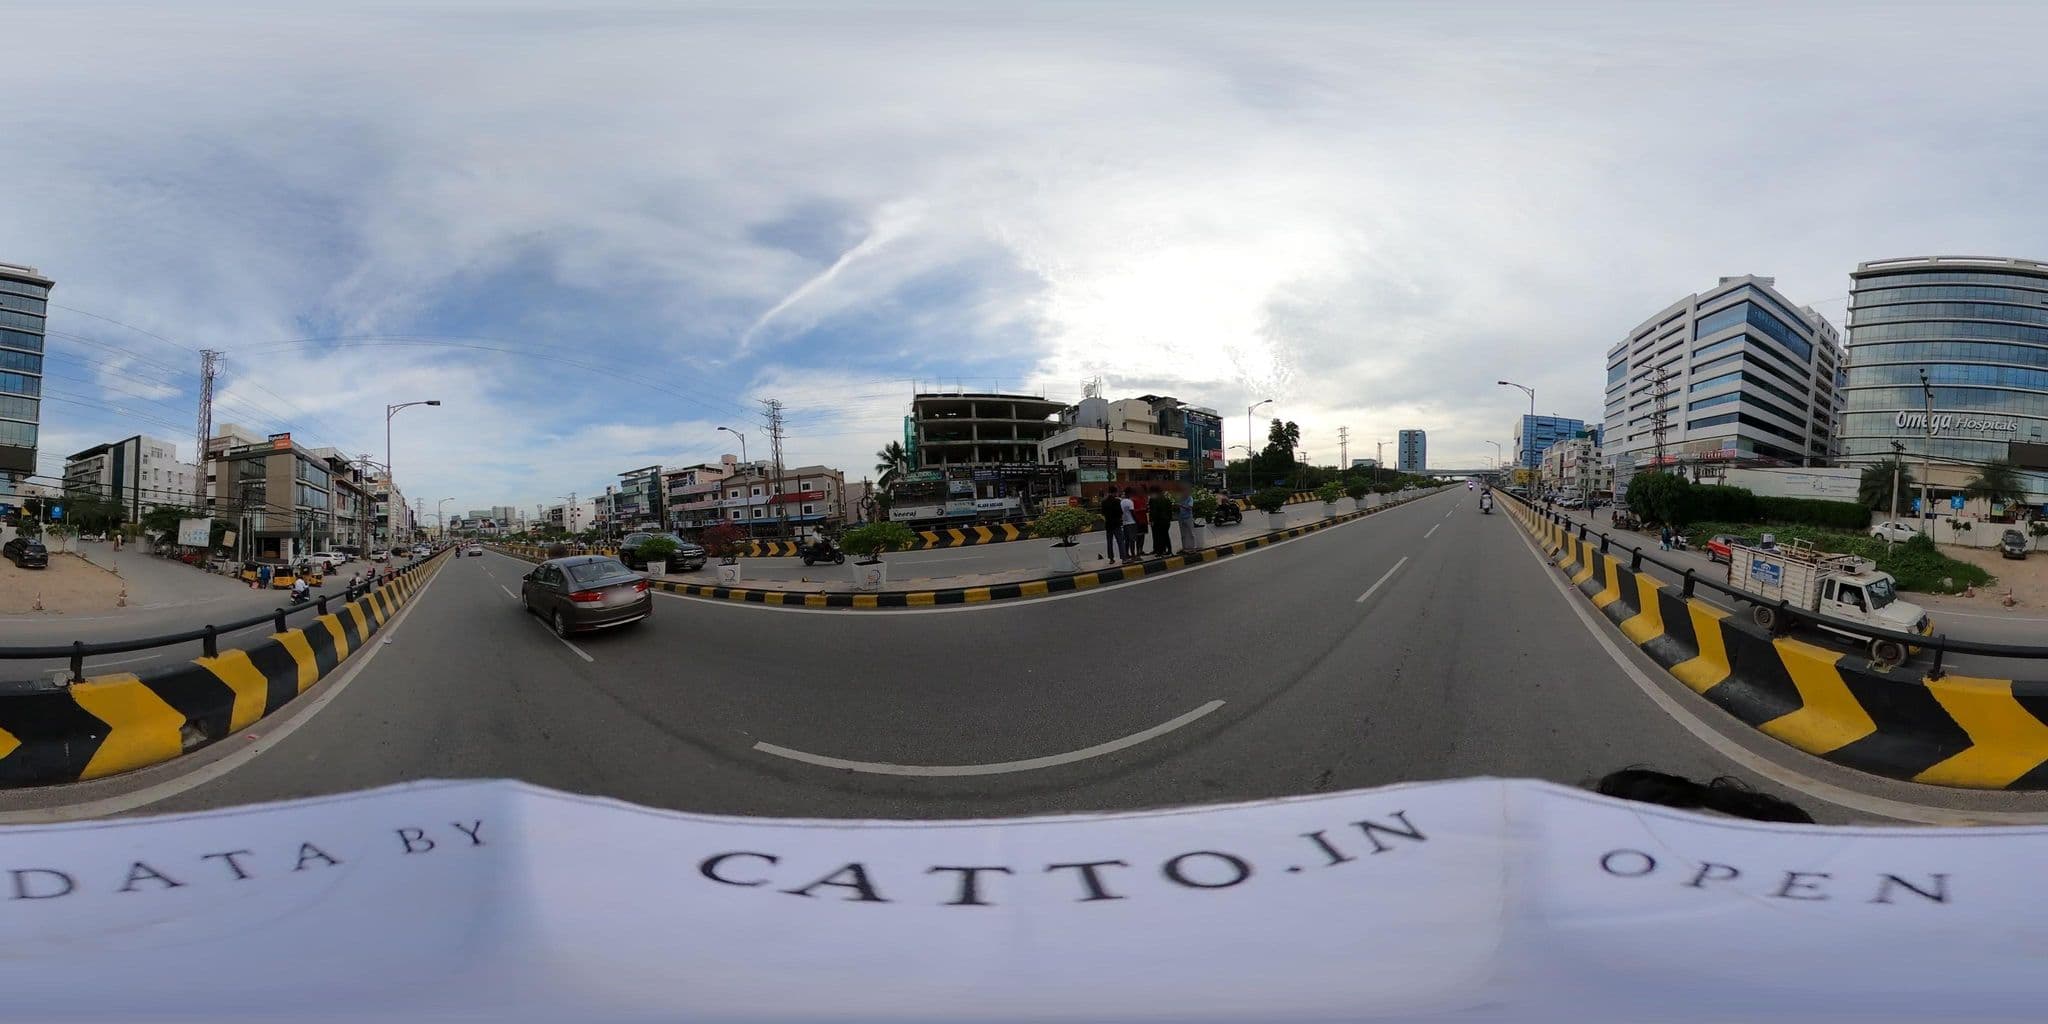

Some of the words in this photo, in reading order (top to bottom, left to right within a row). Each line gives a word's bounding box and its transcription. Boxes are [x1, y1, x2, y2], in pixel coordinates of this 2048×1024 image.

[1895, 410, 1953, 436] Omega
[1955, 417, 2018, 432] Hospitals
[8, 842, 342, 900] DATA
[395, 819, 487, 855] BY
[700, 810, 1429, 906] CATTO.IN
[1600, 848, 1954, 905] OPEN
